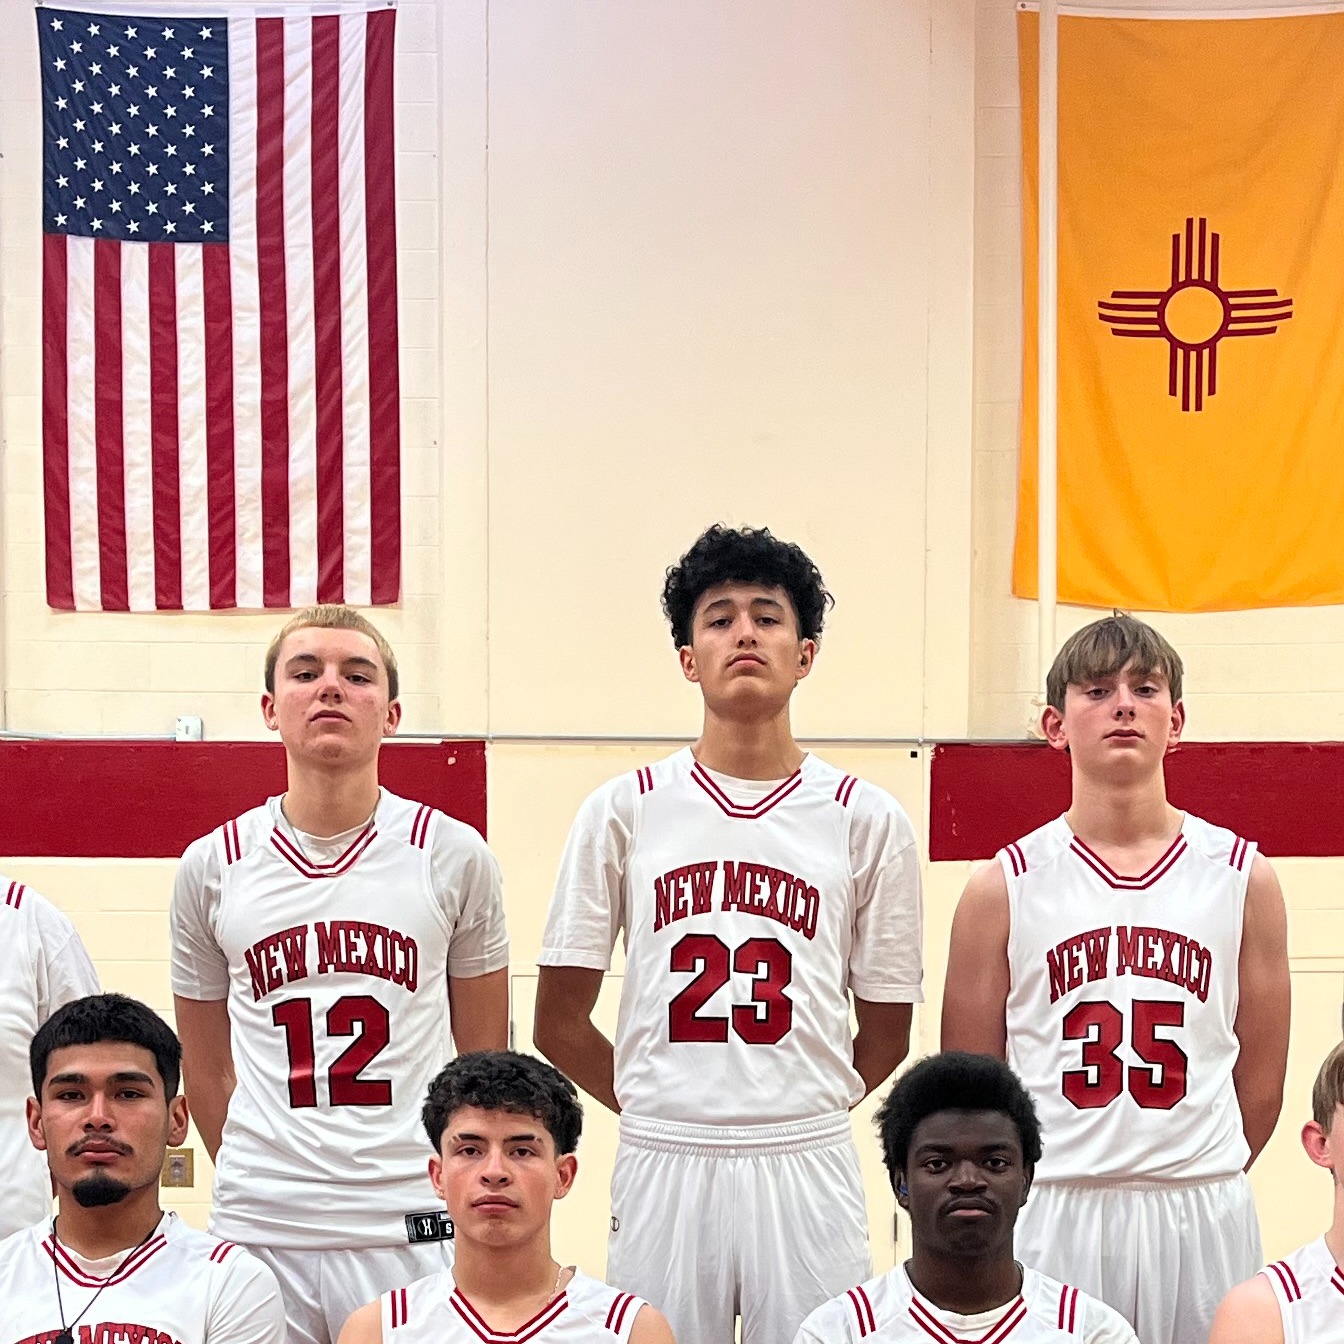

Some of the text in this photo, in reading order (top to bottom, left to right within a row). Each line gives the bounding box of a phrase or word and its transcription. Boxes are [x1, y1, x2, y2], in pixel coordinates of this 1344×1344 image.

[654, 861, 819, 941] NEW MEXICO
[244, 921, 417, 1003] NEW MEXICO
[669, 933, 792, 1045] 23
[1047, 926, 1212, 1005] NEW MEXICO
[272, 995, 392, 1108] 12
[1062, 999, 1188, 1110] 35
